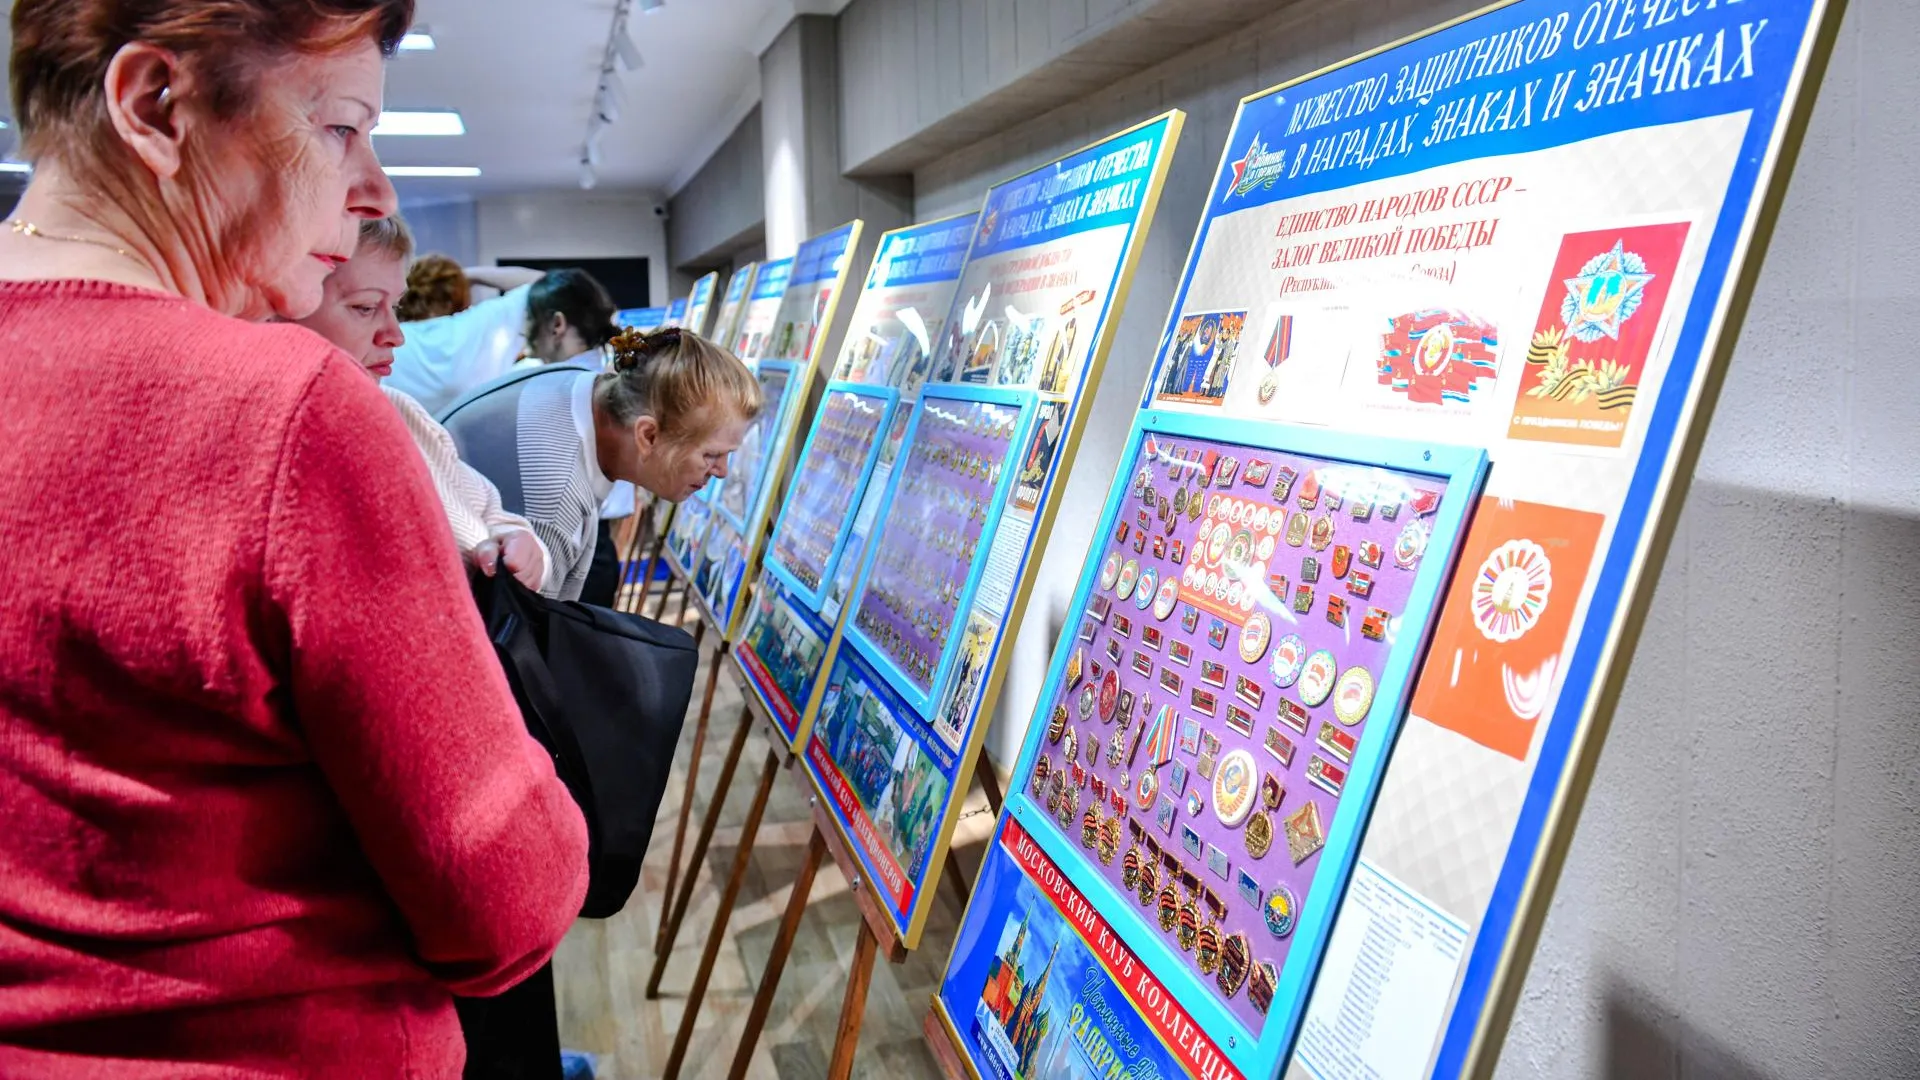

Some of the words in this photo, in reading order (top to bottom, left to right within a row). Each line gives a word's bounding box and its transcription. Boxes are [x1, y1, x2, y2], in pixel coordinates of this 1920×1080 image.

[1284, 72, 1388, 137] МУЖЕСТВО
[1388, 12, 1569, 106] ЗАЩИТНИКОВ
[1288, 142, 1308, 180] В
[1303, 112, 1419, 176] НАГРАДАХ,
[1422, 78, 1543, 147] ЗНАКАХ
[1541, 69, 1577, 122] И
[1573, 18, 1769, 112] ЗНАЧКАХ
[1271, 242, 1319, 270] ЗАЛОГ
[1318, 226, 1403, 264] ВЕЛИКОЙ
[1404, 218, 1500, 255] ПОБЕДЫ
[1275, 203, 1358, 239] ЕДИНСТВО
[1358, 186, 1449, 224] НАРОДОВ
[1452, 176, 1512, 209] СССР
[1015, 834, 1098, 937] МОСКОВСКИЙ
[1098, 926, 1136, 979] КЛУБ
[1081, 966, 1141, 1058] Истинные
